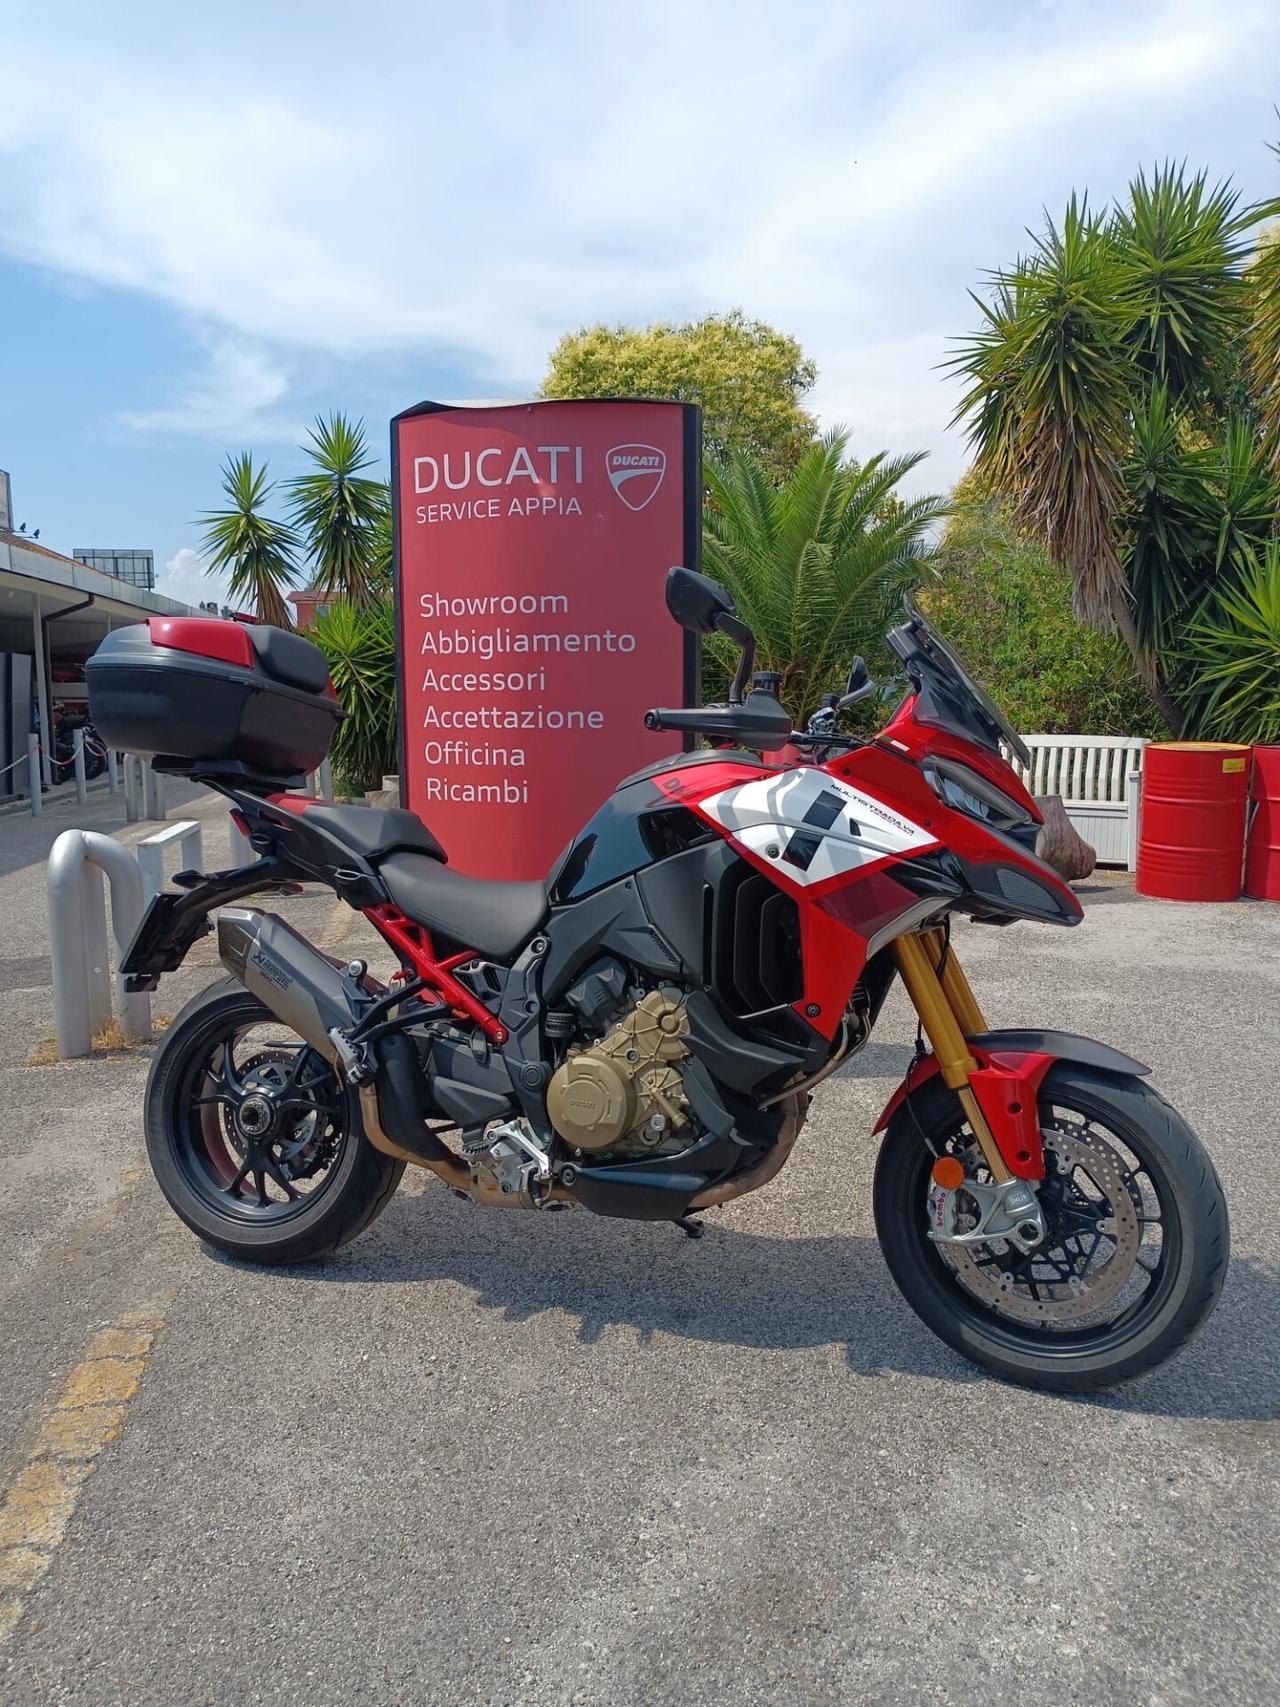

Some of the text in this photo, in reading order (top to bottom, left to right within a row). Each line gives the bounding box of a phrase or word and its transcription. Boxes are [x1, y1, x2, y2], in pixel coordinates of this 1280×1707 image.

[414, 446, 583, 494] DUCATI
[612, 455, 660, 467] DUCATI
[416, 497, 583, 524] SERVICE APPIA
[419, 592, 569, 618] Showroom
[420, 629, 636, 660] Abbigliamento
[422, 667, 546, 692] Accessori
[423, 705, 605, 730] Accettazione
[424, 742, 526, 767] Officina
[426, 778, 529, 804] Ricambi
[830, 784, 902, 826] MULTISTRADA
[570, 1098, 596, 1109] DUCATI
[935, 1192, 947, 1229] brembo
